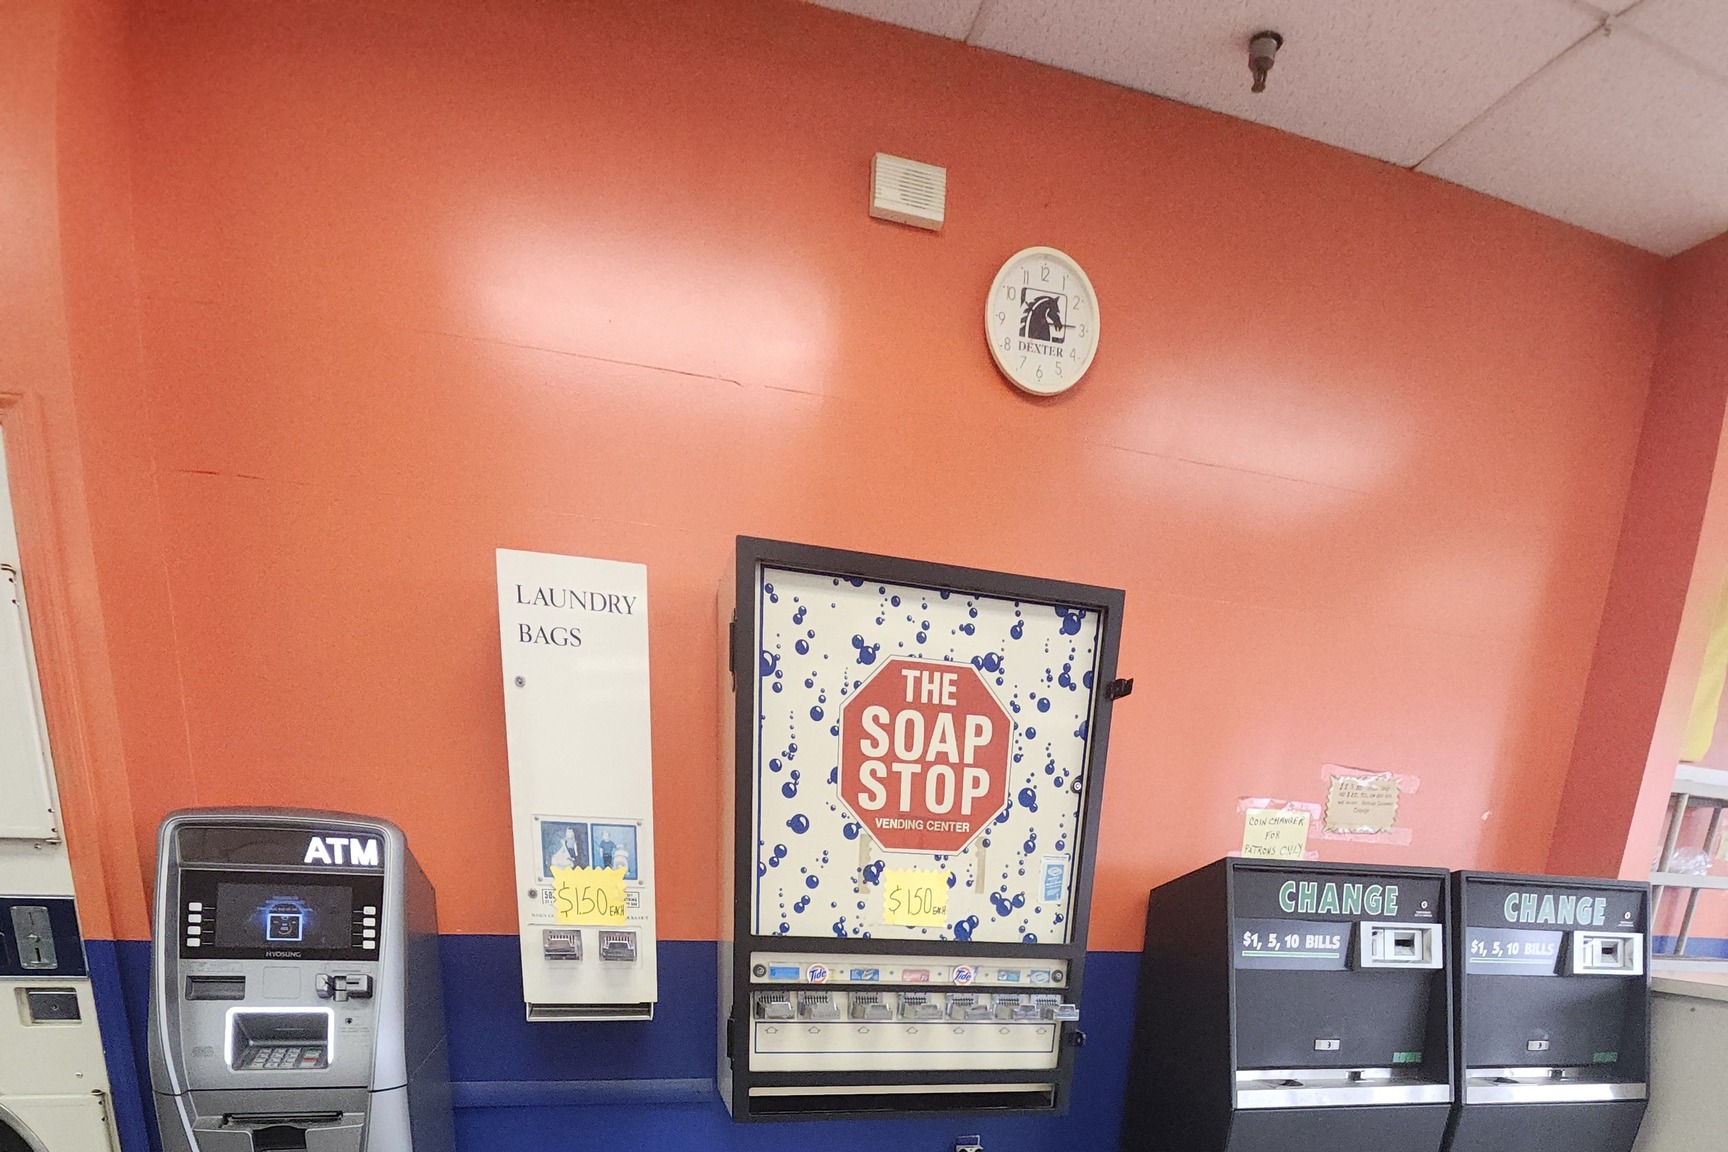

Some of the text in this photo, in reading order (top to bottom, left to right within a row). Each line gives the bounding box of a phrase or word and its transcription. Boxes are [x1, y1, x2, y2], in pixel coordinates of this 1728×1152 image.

[1023, 270, 1029, 285] 11
[1040, 265, 1050, 282] 12
[1006, 286, 1016, 301] 10
[1072, 295, 1080, 310] 2
[998, 312, 1006, 325] 9
[1079, 324, 1086, 338] 3
[1004, 338, 1011, 351] 8
[1018, 341, 1064, 358] DEXTER
[1069, 348, 1076, 362] 4
[1020, 356, 1027, 370] 7
[1055, 362, 1062, 376] 5
[1036, 365, 1043, 379] 6
[515, 584, 637, 615] LAUNDRY
[518, 623, 582, 647] BAGS
[901, 668, 958, 706] THE
[860, 705, 993, 764] SOAP
[857, 759, 990, 815] STOP
[875, 817, 970, 832] VENDING CENTER
[1249, 816, 1305, 826] COIN CHANGER
[1265, 831, 1280, 839] FOR
[304, 837, 378, 865] ATM
[1244, 844, 1303, 858] PATRONS ONLY
[1279, 880, 1398, 916] CHANGE
[609, 905, 625, 916] EACH
[1504, 893, 1606, 926] CHANGE
[1243, 931, 1341, 950] $1, 5, 10 BILLS
[1471, 939, 1554, 957] $1, 5, 10 BILLS
[809, 969, 827, 981] Tide
[954, 970, 971, 981] Tide
